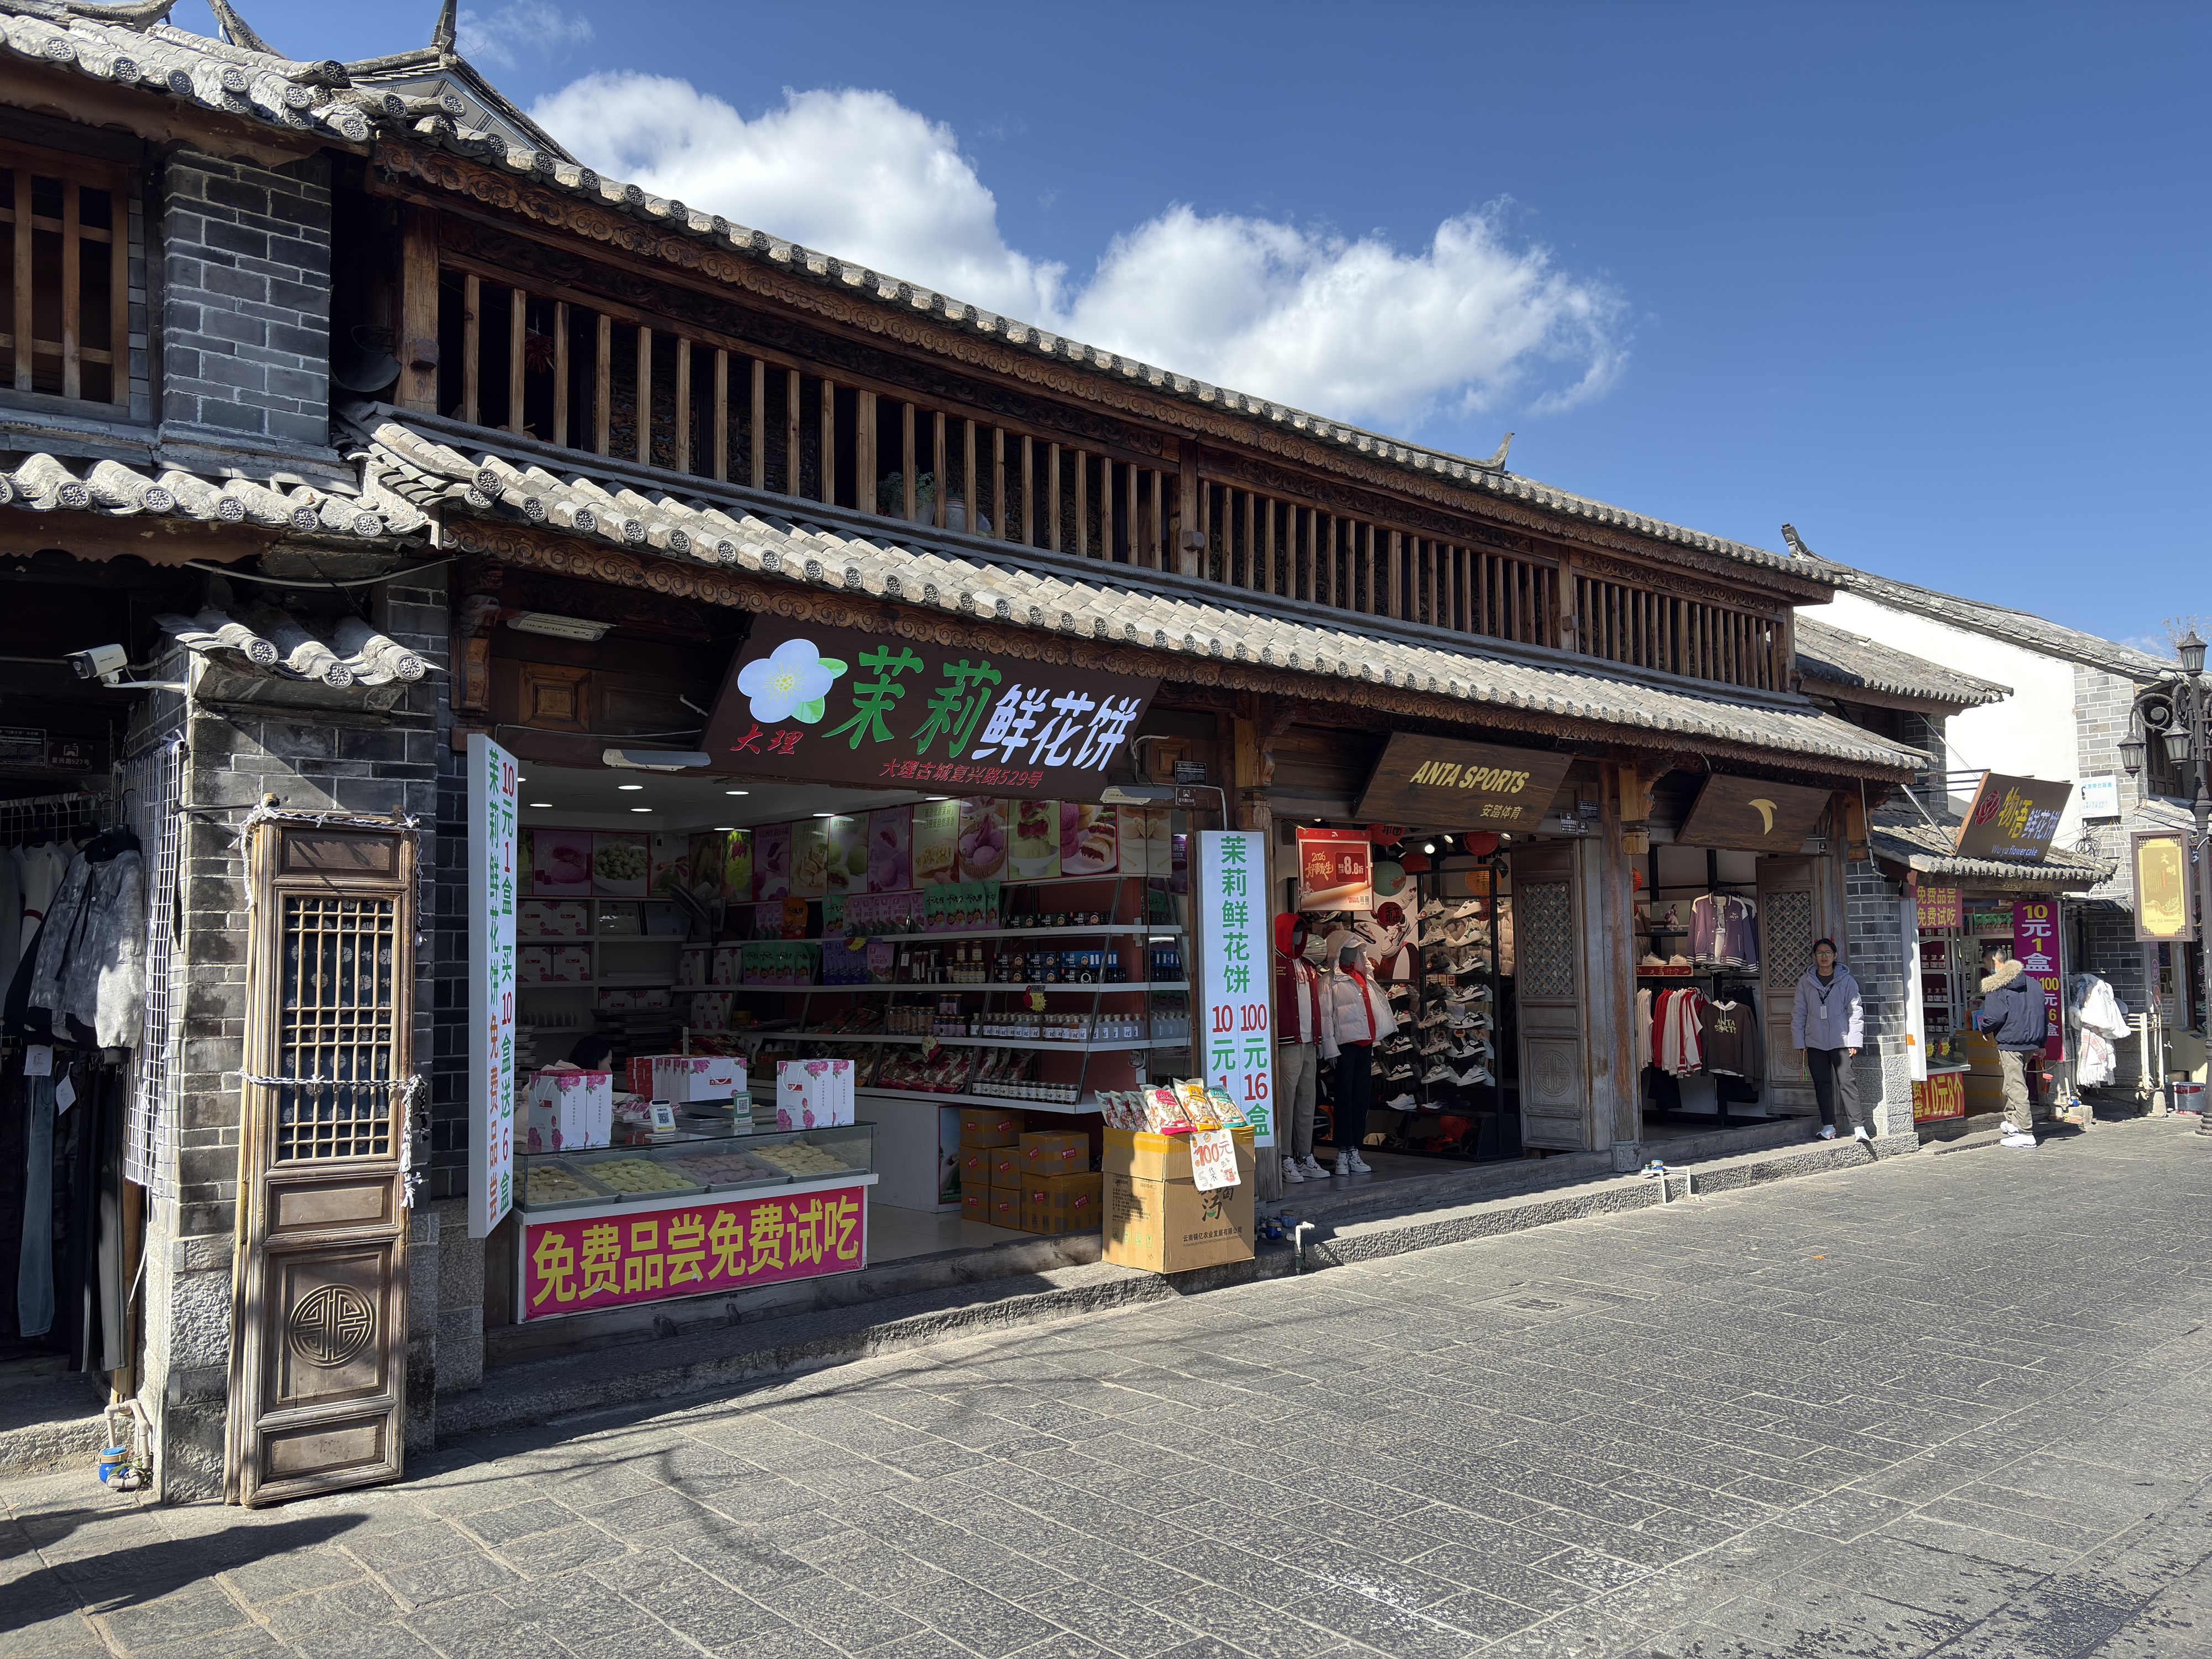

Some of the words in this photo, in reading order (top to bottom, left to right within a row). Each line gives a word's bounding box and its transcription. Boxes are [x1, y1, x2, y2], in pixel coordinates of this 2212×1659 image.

[729, 723, 804, 755] 大理
[879, 758, 1044, 787] 大理古城复兴路529号
[1409, 760, 1463, 787] ANTA
[1458, 766, 1530, 794] SPORTS
[1480, 804, 1523, 820] 安踏体育
[1311, 851, 1326, 863] 2026
[1991, 844, 2001, 854] Wu
[2000, 847, 2007, 857] yu
[2009, 845, 2027, 855] flower
[2026, 847, 2038, 856] cake
[1305, 860, 1334, 881] 好事发生
[2160, 853, 2177, 876] 文明
[1220, 836, 1251, 994] 茉莉鲜花饼
[1385, 906, 1401, 923] 福
[1917, 906, 1957, 926] 免费试吃
[1717, 1018, 1735, 1026] ANTA
[1923, 1072, 1963, 1117] 10元8个
[1193, 1140, 1233, 1166] 100元
[532, 1194, 859, 1307] 免费品尝免费试吃
